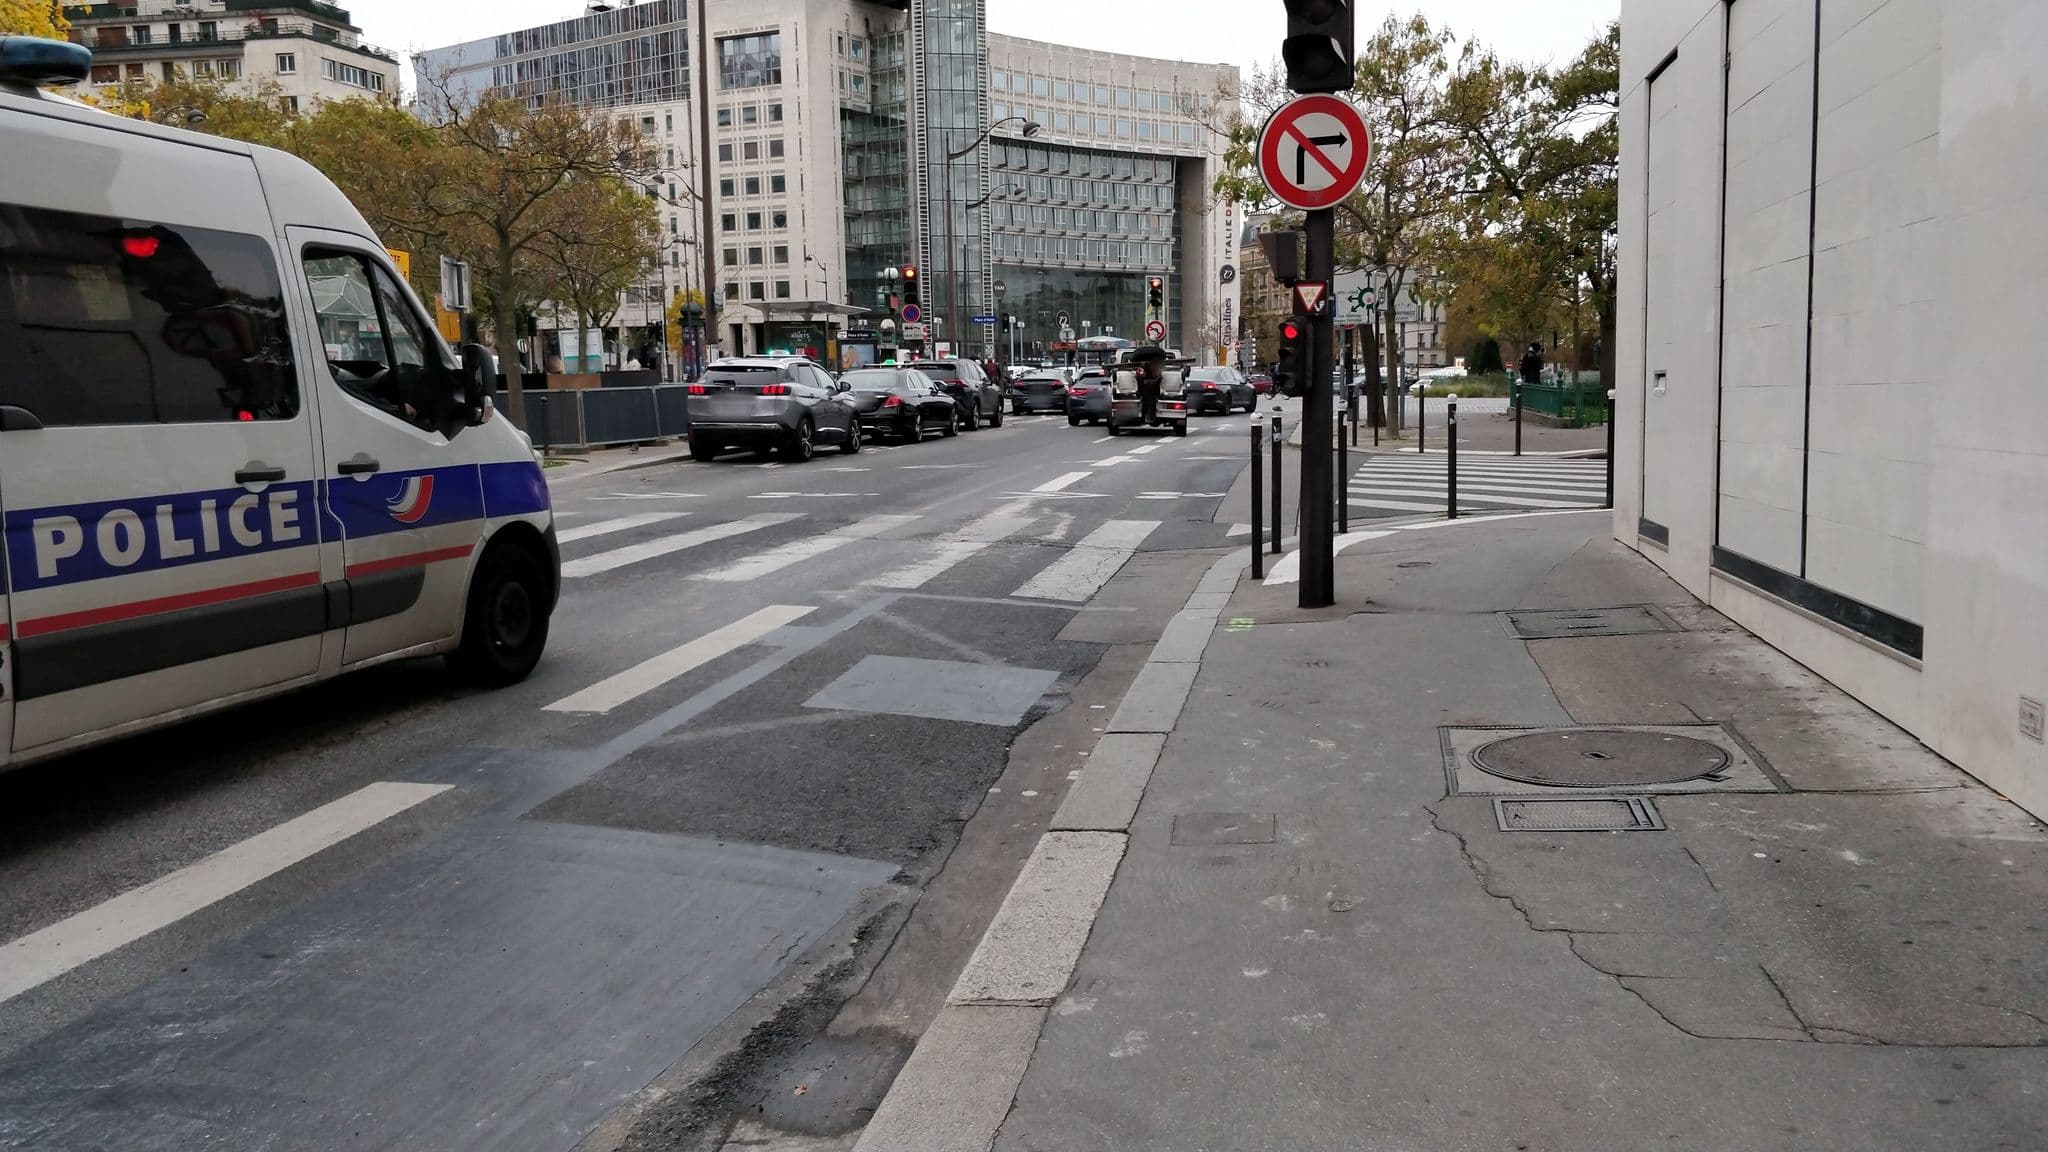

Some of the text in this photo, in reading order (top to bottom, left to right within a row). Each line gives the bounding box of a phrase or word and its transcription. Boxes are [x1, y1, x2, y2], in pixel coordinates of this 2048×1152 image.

[1225, 219, 1233, 260] ITALIE
[1222, 297, 1232, 346] Citadines
[32, 489, 302, 579] POLICE
